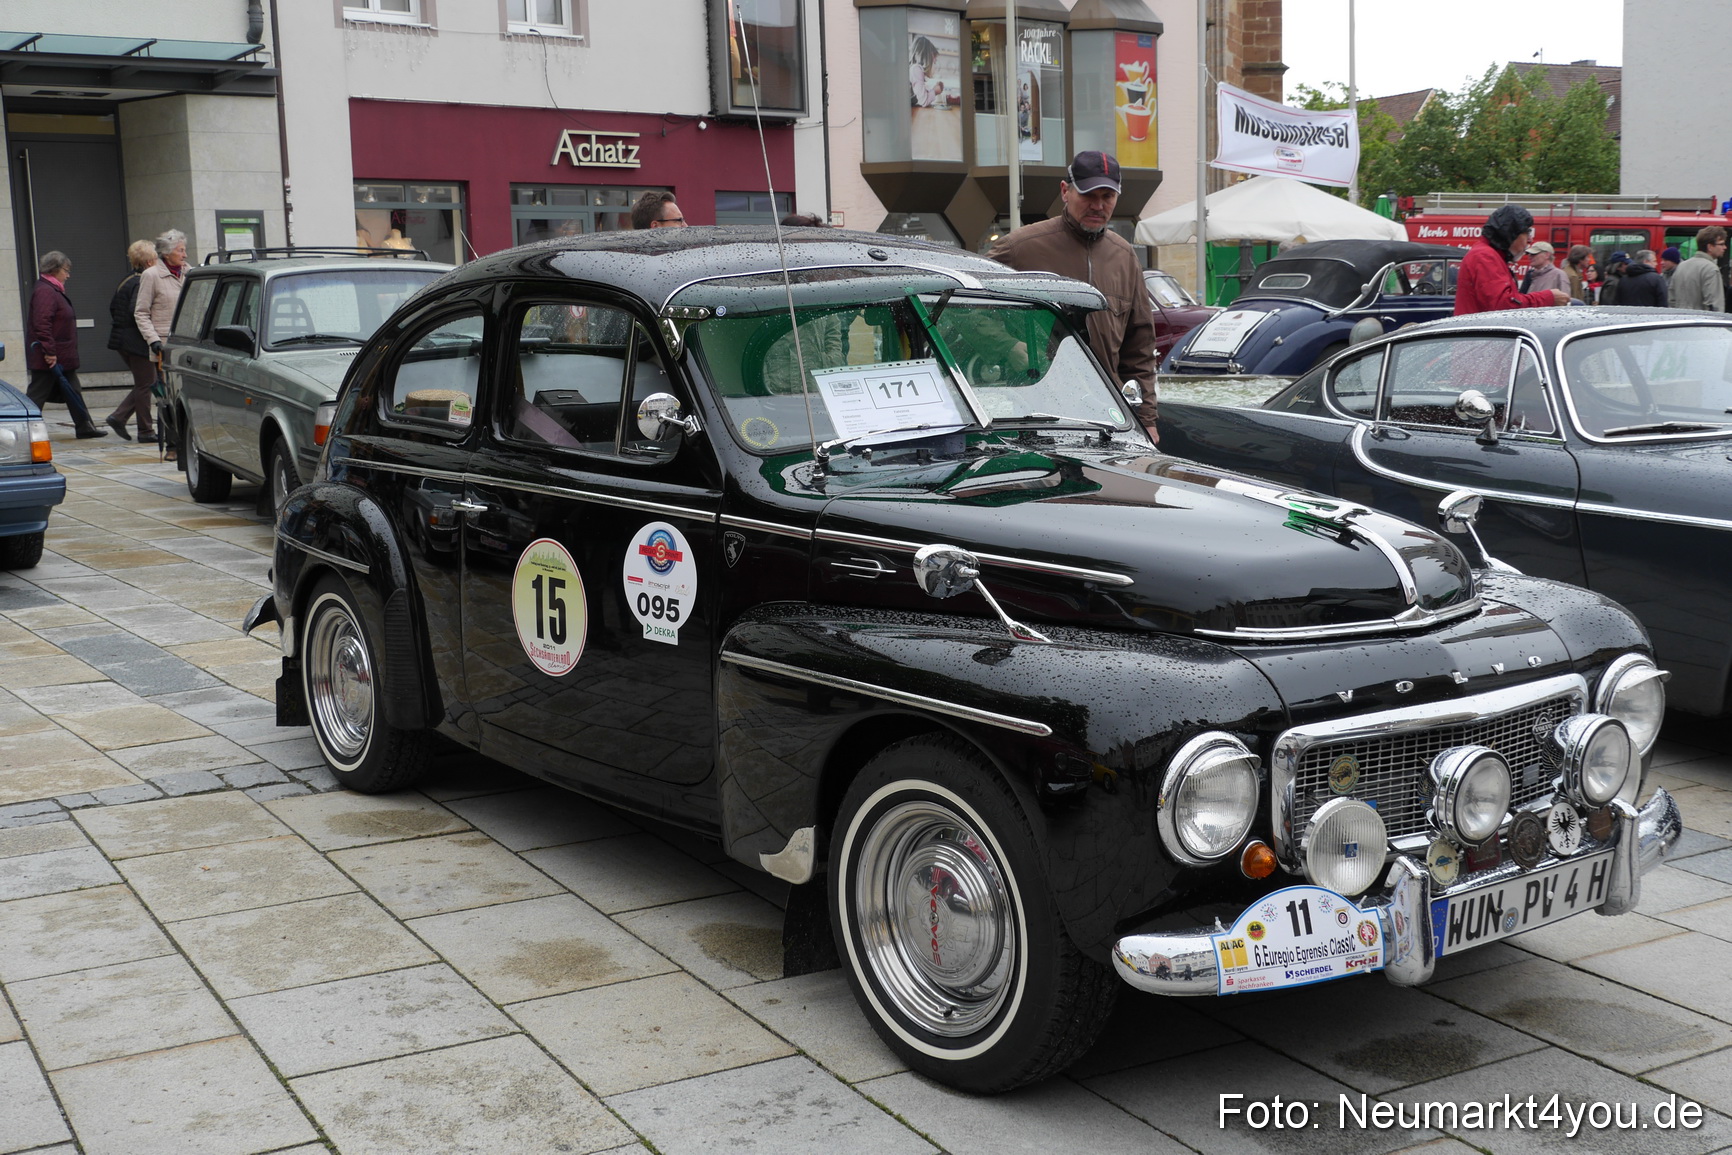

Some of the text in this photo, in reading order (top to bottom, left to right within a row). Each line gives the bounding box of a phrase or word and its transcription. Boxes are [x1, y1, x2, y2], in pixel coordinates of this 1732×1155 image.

[1023, 28, 1056, 39] 100 Jahre
[1020, 40, 1052, 65] RACKL
[1233, 103, 1349, 149] Museumsinsel
[551, 129, 641, 167] Achatz
[878, 379, 919, 399] 171
[532, 574, 567, 645] 15
[637, 592, 680, 623] 095
[654, 627, 676, 639] DEKRA
[1316, 655, 1543, 702] VOLVO
[1285, 898, 1313, 937] 11
[1447, 858, 1608, 947] WUN PV 4 H
[1295, 941, 1329, 964] Egrensis
[1329, 930, 1356, 956] Classic
[1295, 965, 1333, 978] SCHERDEL
